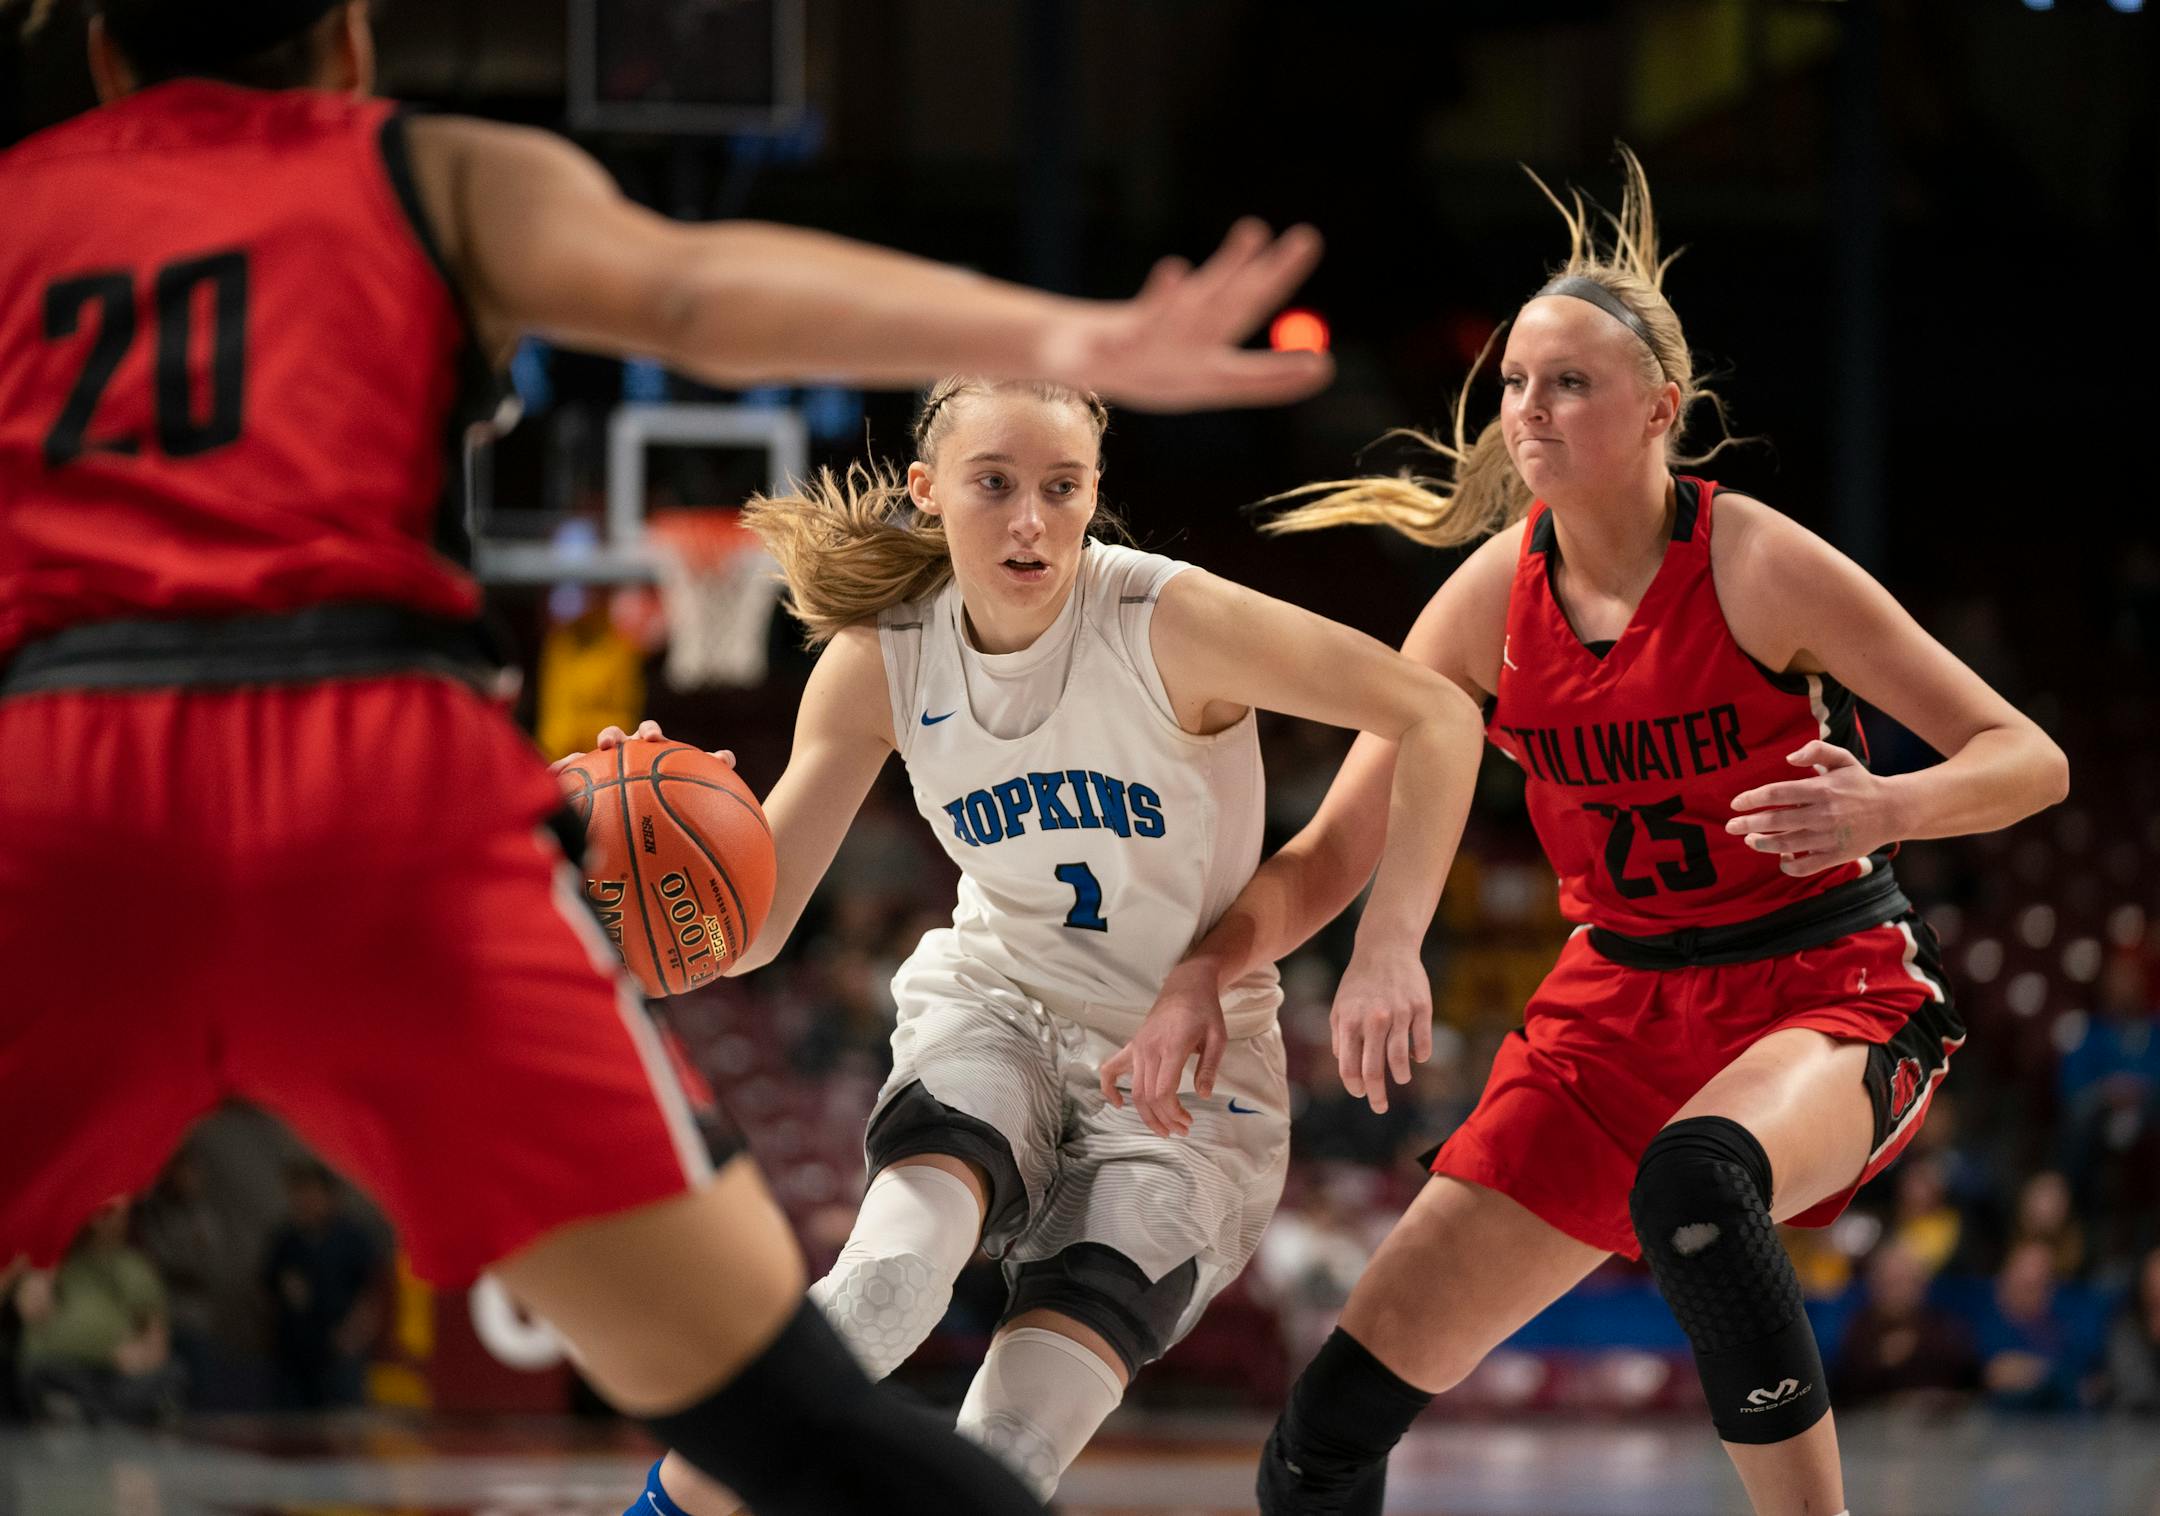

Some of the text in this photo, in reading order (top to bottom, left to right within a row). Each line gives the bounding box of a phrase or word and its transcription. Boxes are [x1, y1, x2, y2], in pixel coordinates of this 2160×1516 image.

[44, 247, 249, 473] 20
[1583, 794, 1718, 899] 25
[703, 915, 727, 961] LEGACY
[1054, 862, 1107, 932] 1
